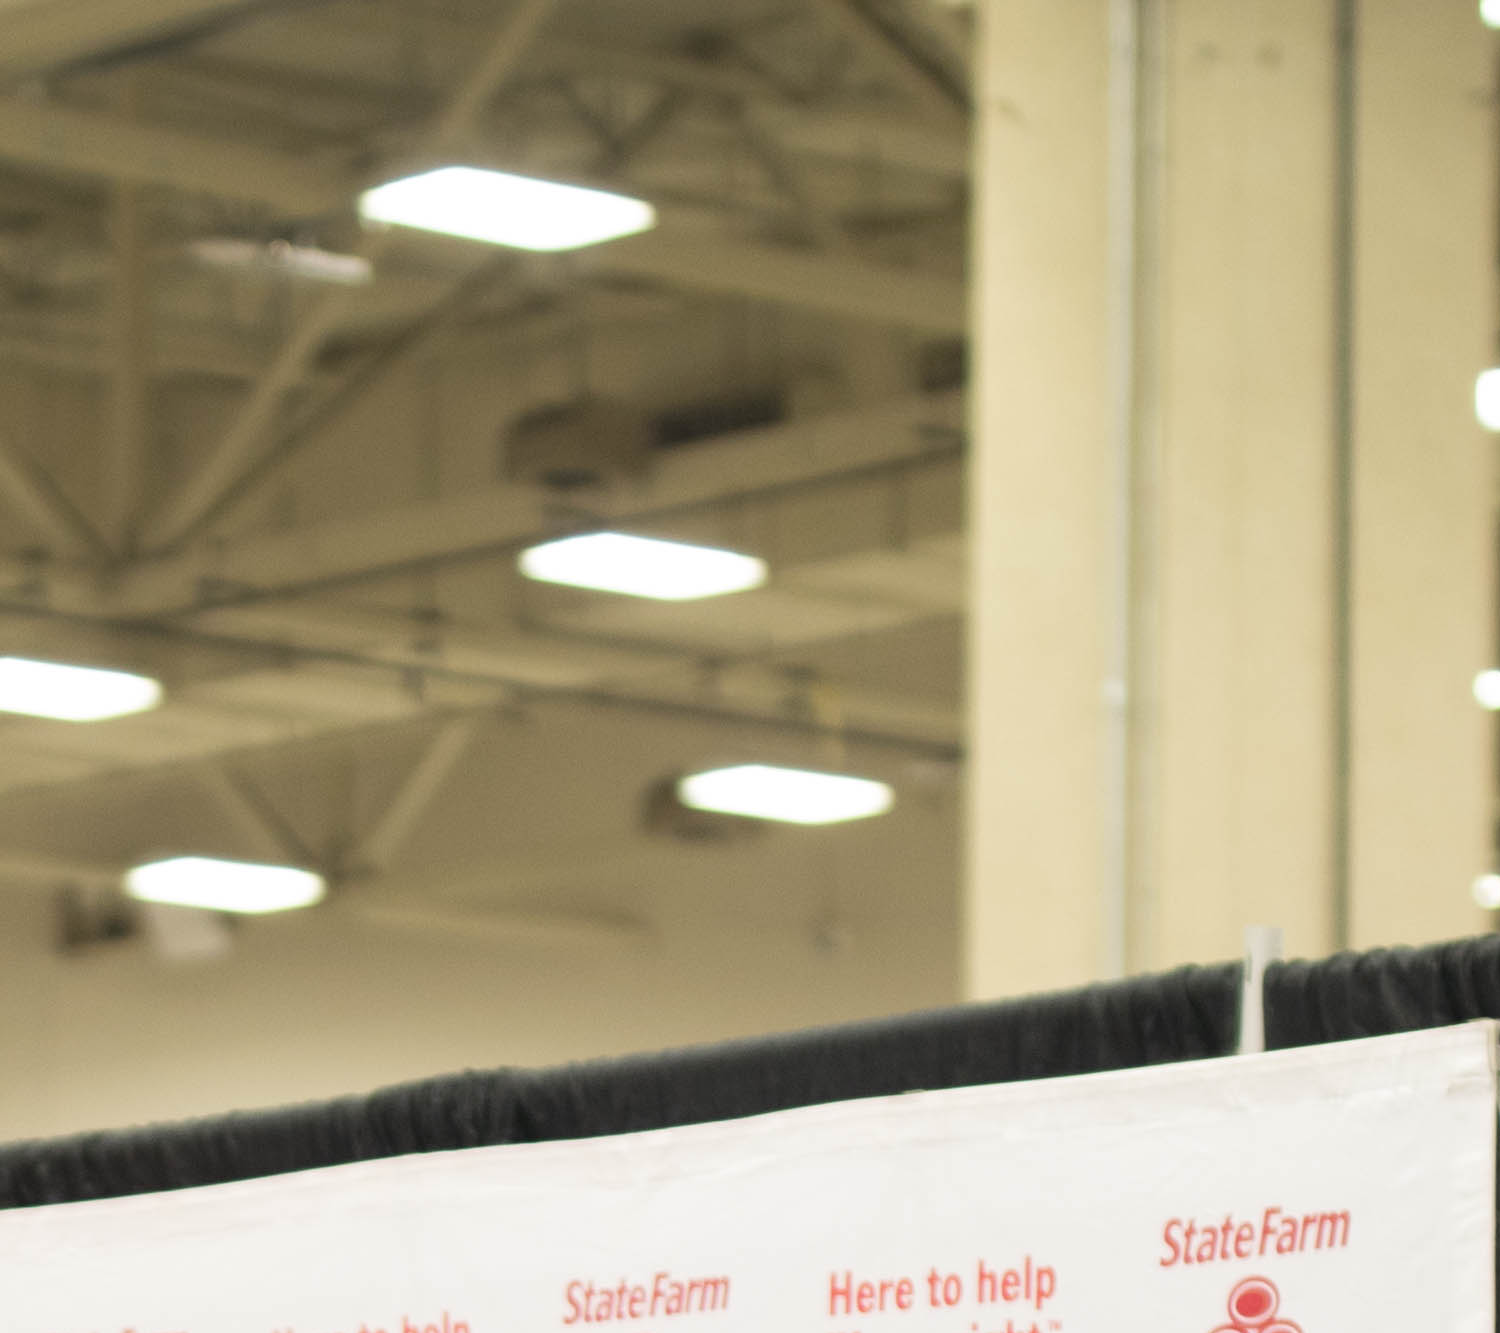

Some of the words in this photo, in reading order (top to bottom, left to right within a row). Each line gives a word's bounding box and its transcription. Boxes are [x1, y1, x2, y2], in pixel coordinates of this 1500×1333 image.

[828, 1274, 913, 1316] Here
[927, 1269, 963, 1308] to
[976, 1257, 1056, 1310] help
